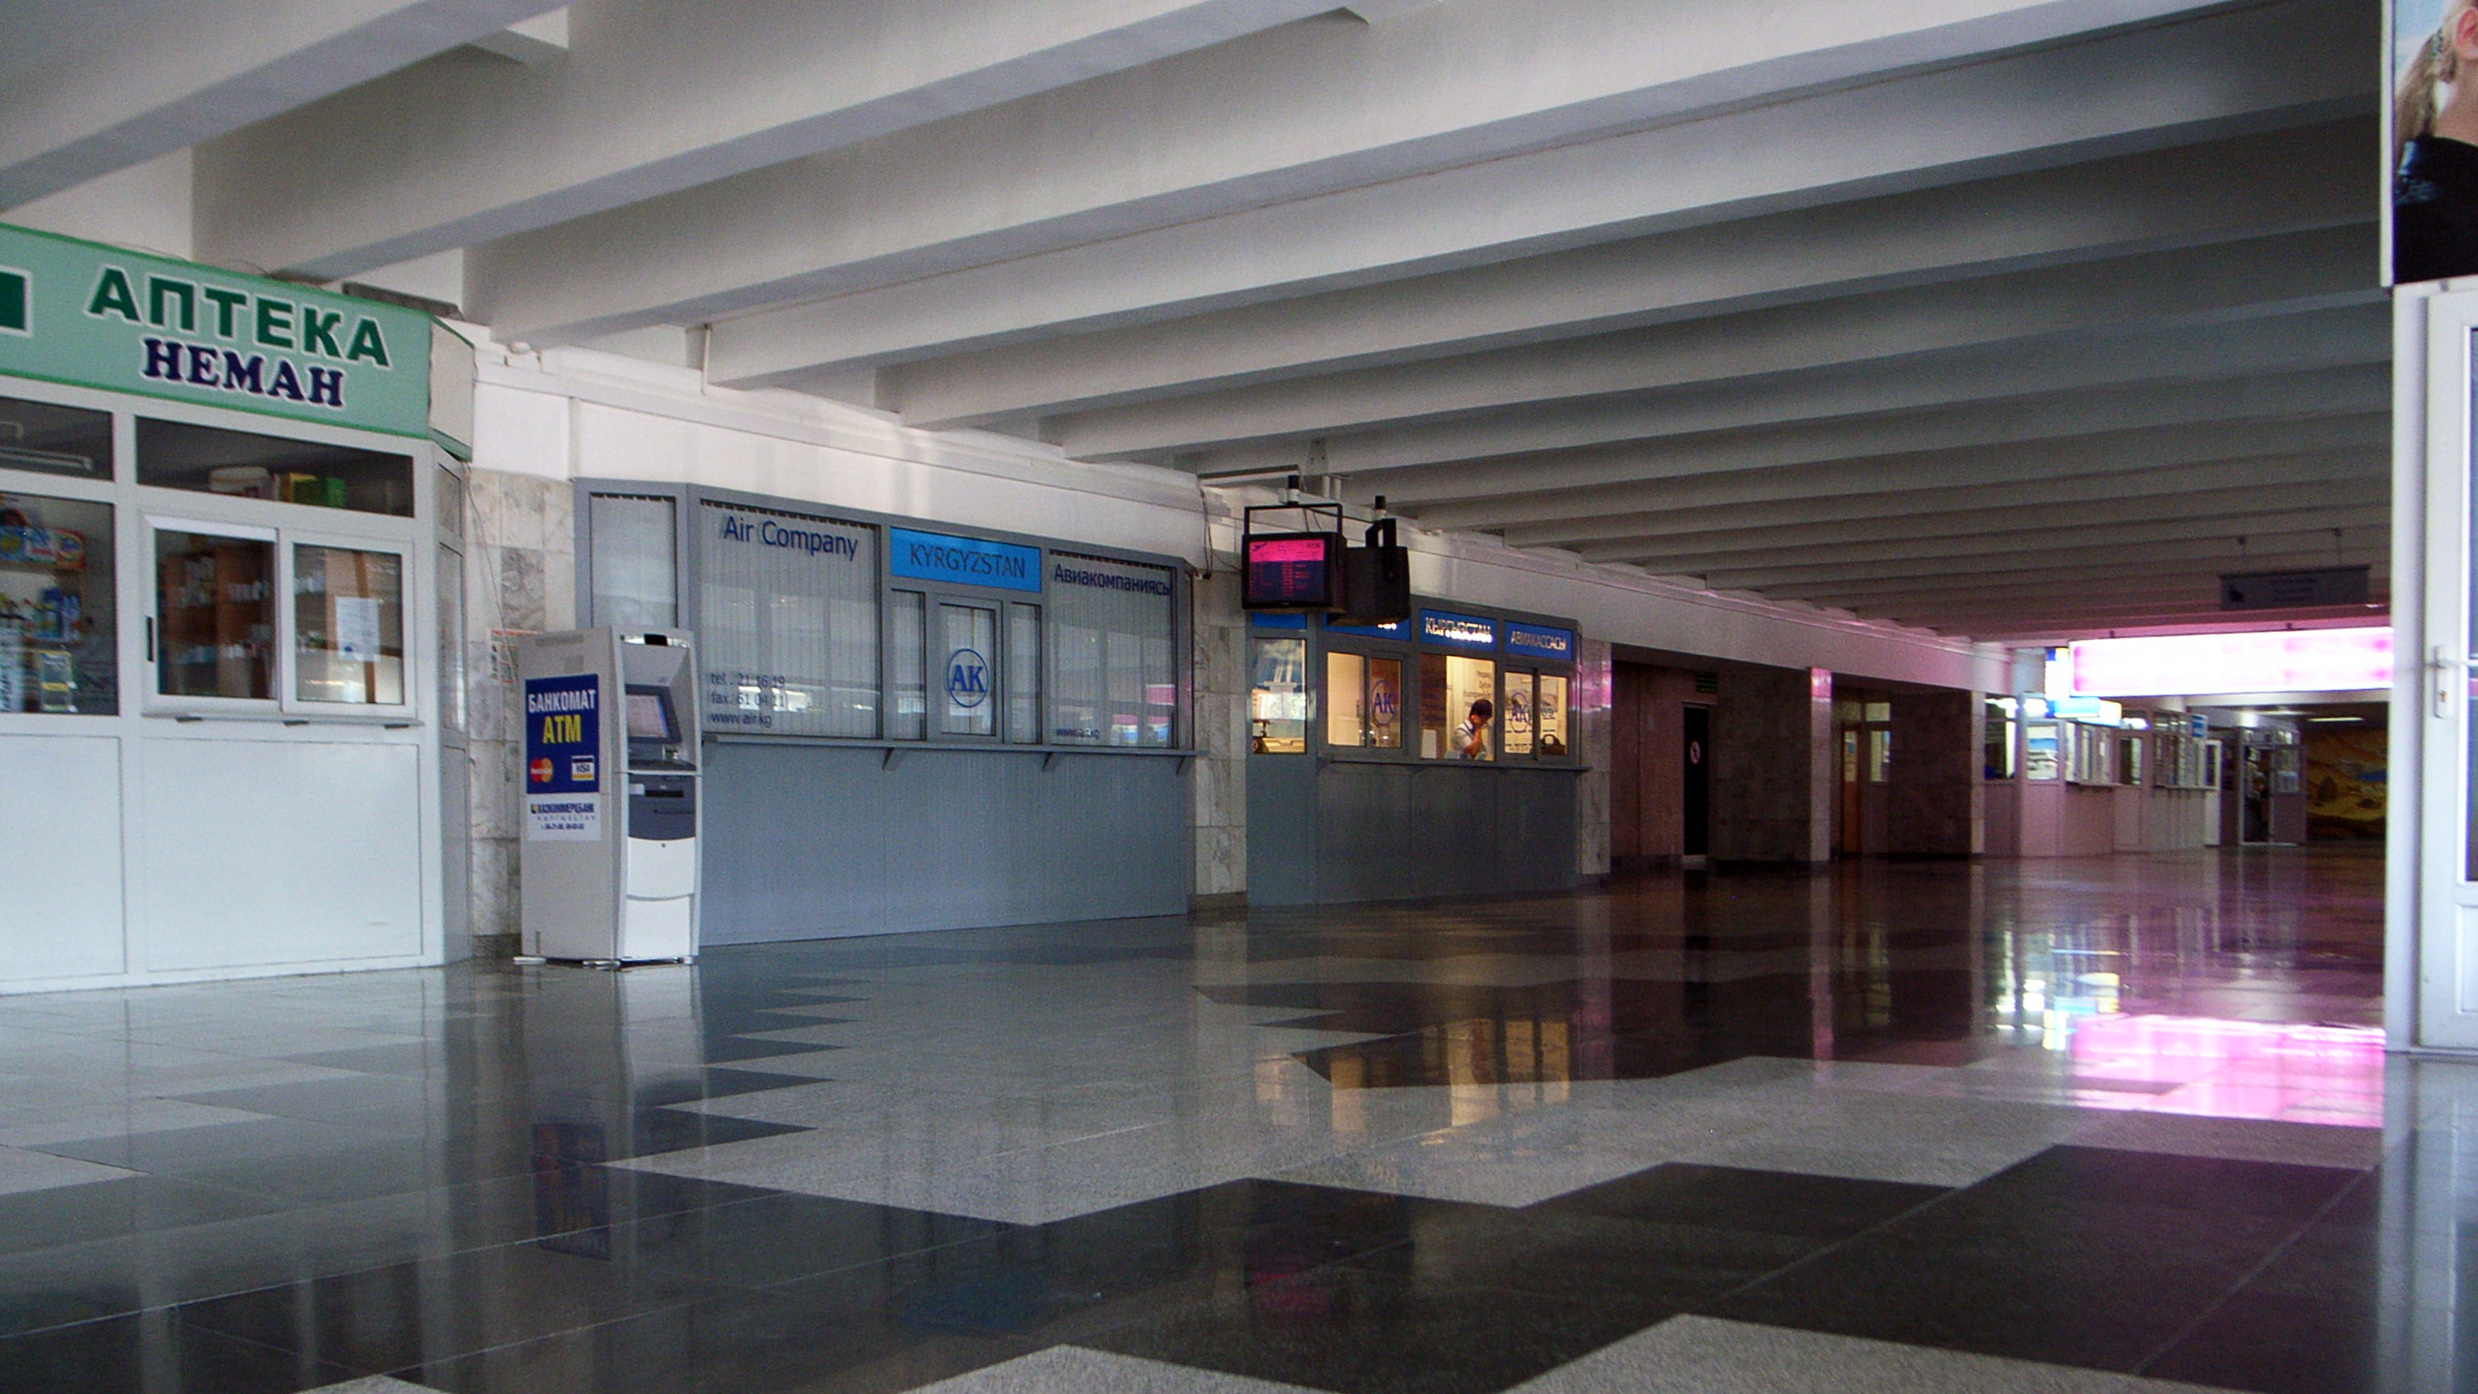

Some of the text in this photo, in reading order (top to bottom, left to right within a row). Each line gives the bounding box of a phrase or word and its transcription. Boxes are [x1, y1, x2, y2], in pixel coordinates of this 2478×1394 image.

[87, 267, 391, 368] АПТЕКА
[142, 337, 345, 407] НЕМАН
[723, 515, 859, 562] Air Company
[909, 543, 1026, 579] KYRGYZSTAN
[756, 674, 769, 688] 16
[773, 675, 786, 689] 19
[527, 689, 596, 714] БАНКОМАТ
[737, 692, 750, 706] 61
[543, 714, 582, 744] ATM
